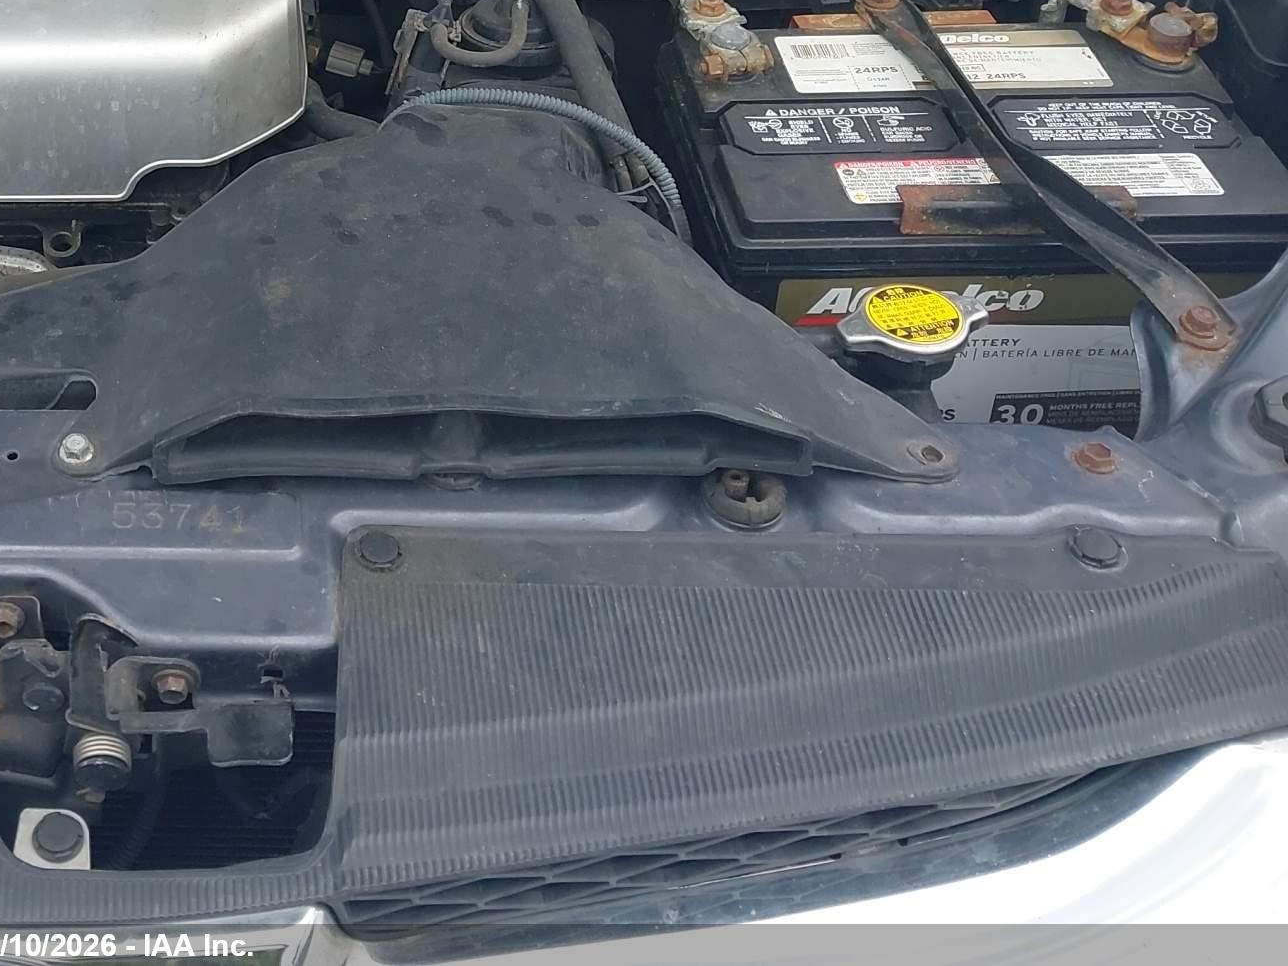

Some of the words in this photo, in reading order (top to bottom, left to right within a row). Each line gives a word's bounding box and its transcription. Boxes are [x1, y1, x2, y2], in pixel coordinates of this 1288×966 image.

[854, 66, 899, 75] 24RPS
[986, 72, 1027, 80] 24RPS
[779, 108, 836, 116] DANGER
[838, 107, 845, 115] /
[849, 106, 900, 115] POISON
[883, 289, 924, 302] CAUTION
[983, 348, 1038, 358] BATERÍA
[1043, 349, 1081, 357] LIBRE
[1088, 348, 1105, 356] DE
[1049, 403, 1088, 411] MONTHS
[1089, 402, 1115, 410] FREE
[996, 403, 1044, 425] 30
[112, 503, 248, 533] 53741
